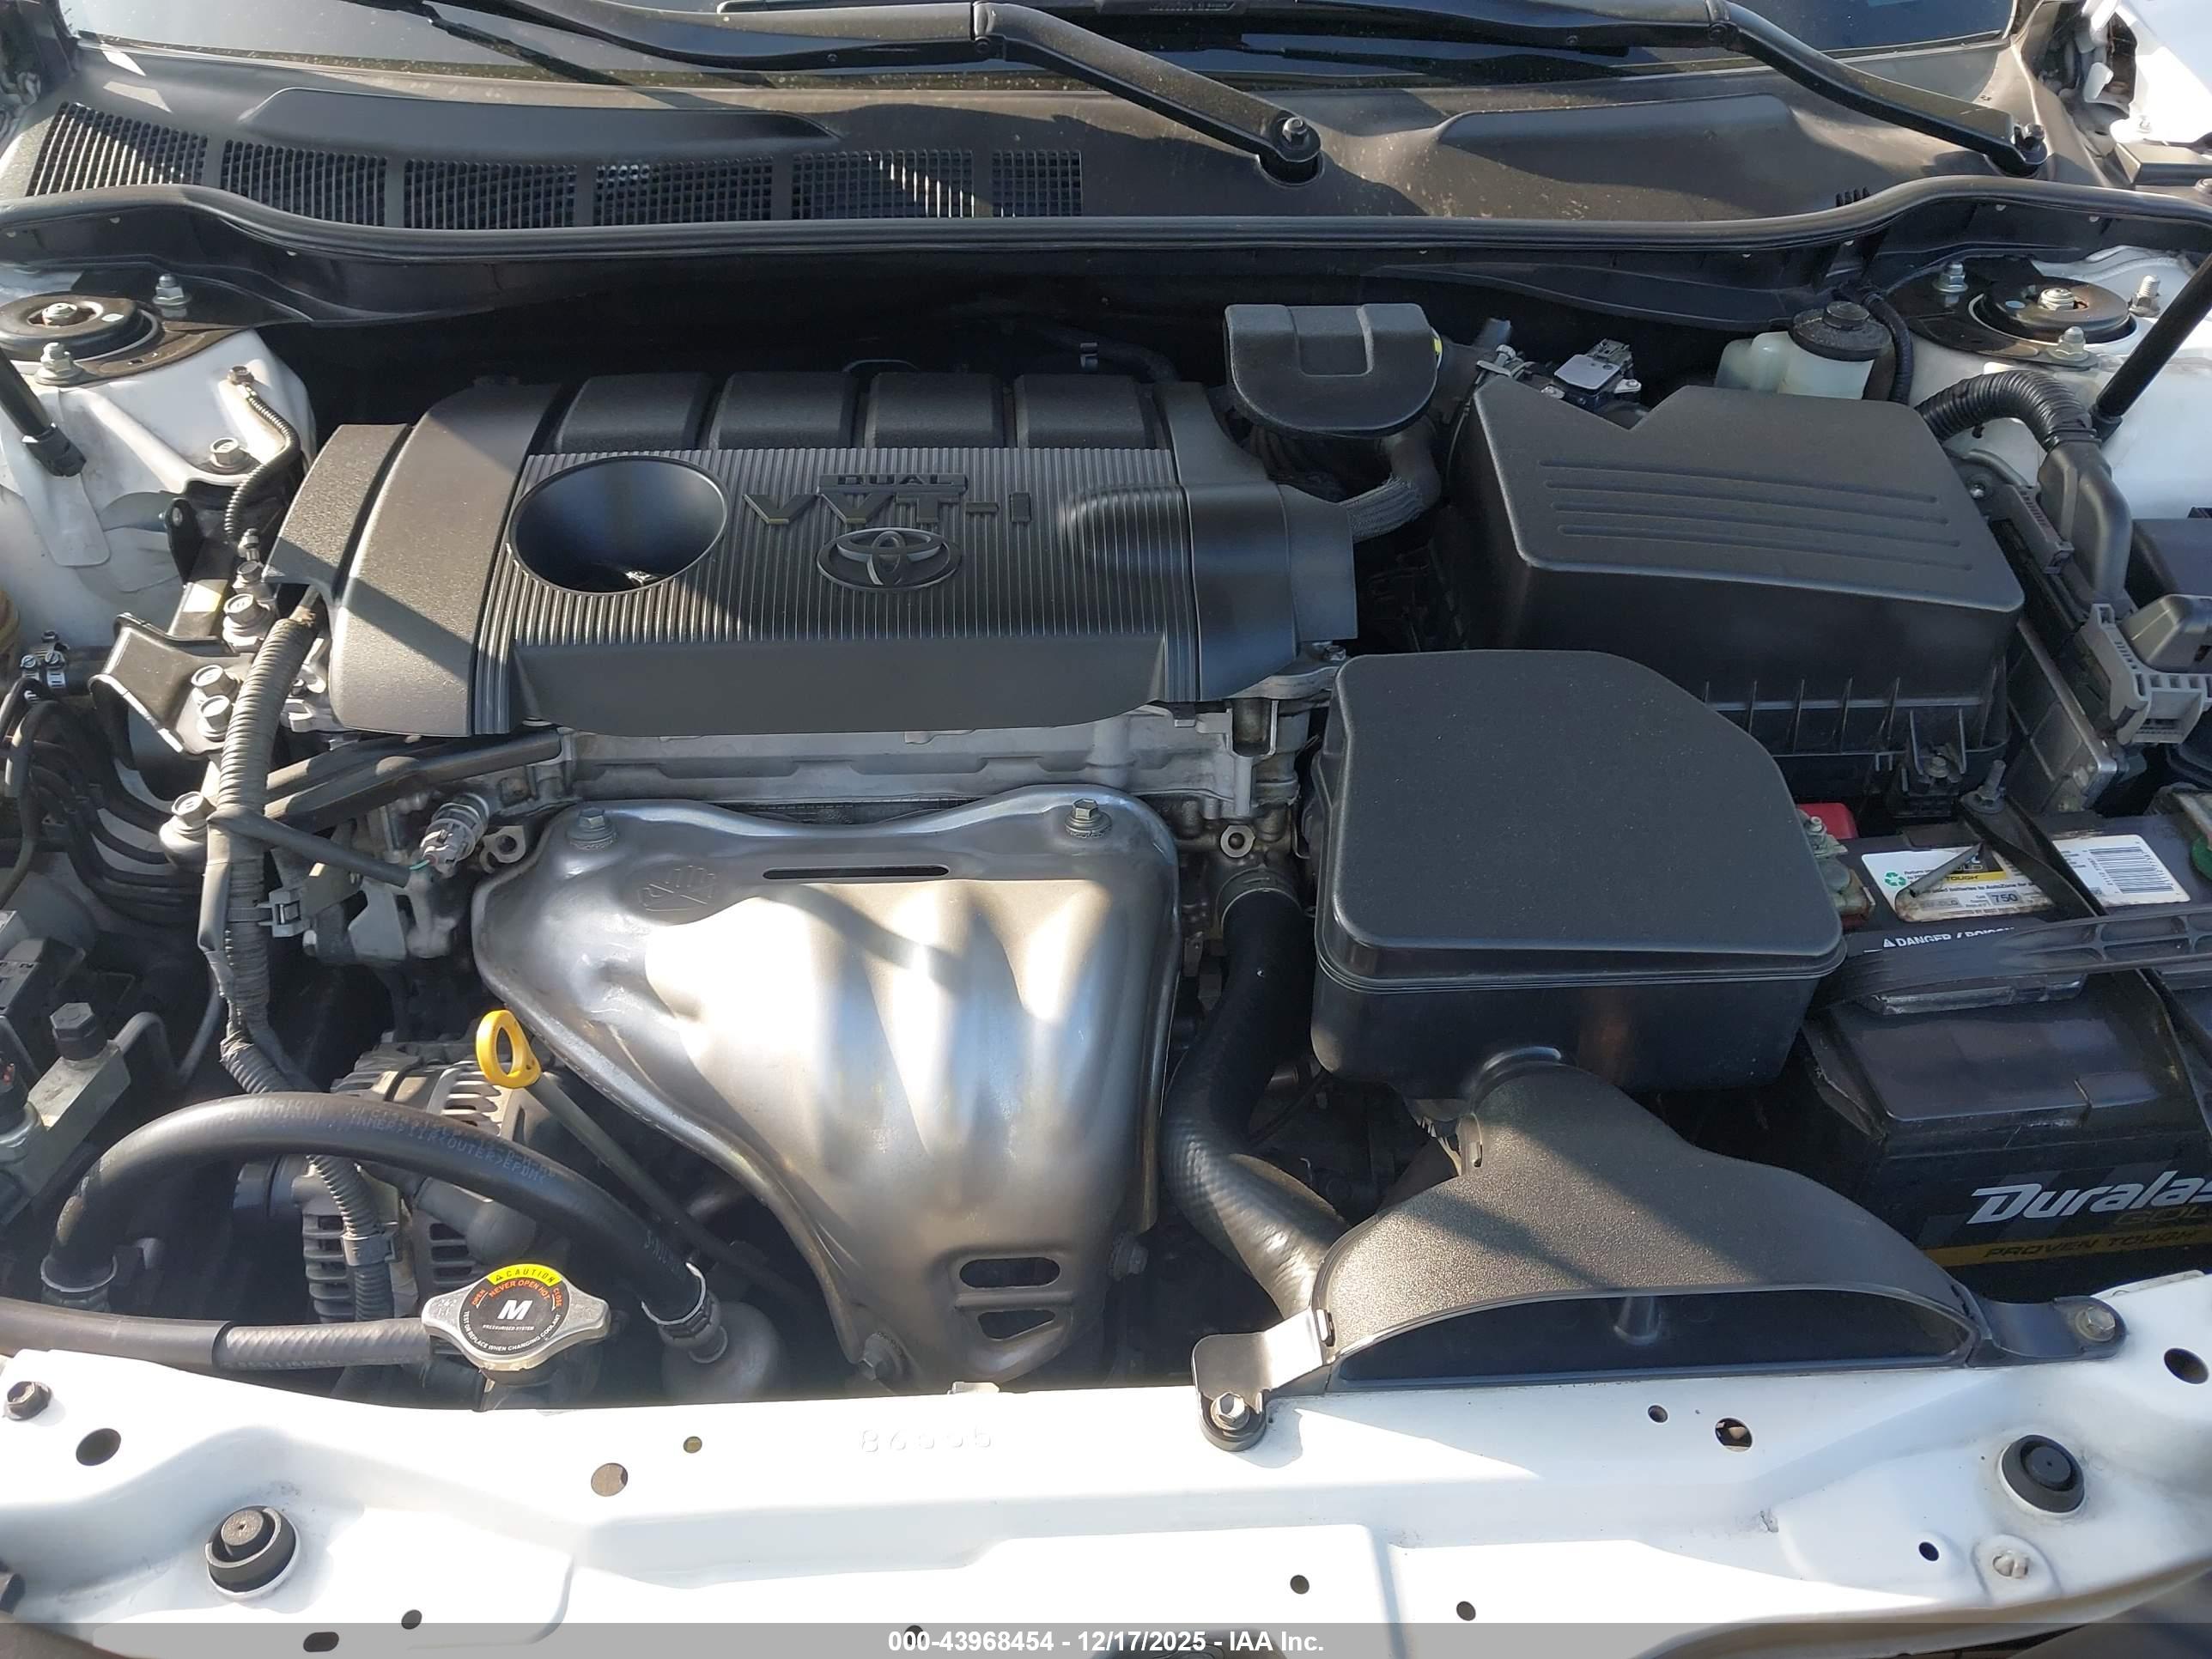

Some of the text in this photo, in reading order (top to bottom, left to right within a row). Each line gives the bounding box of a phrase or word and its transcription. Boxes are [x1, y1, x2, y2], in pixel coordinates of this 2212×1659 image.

[837, 474, 953, 485] DUAL
[1992, 894, 2018, 902] 750
[2115, 1206, 2212, 1225] GOL
[1984, 1228, 2199, 1258] PROVEN TOUGH
[506, 1268, 556, 1283] CAUTION
[471, 1290, 486, 1305] OPEN
[489, 1279, 550, 1300] NEVER OPEN HOT
[553, 1287, 563, 1307] CLOSE
[496, 1299, 533, 1321] M
[467, 1331, 489, 1349] REPLACE
[507, 1336, 541, 1352] CHANGING
[540, 1314, 562, 1338] COOLANT
